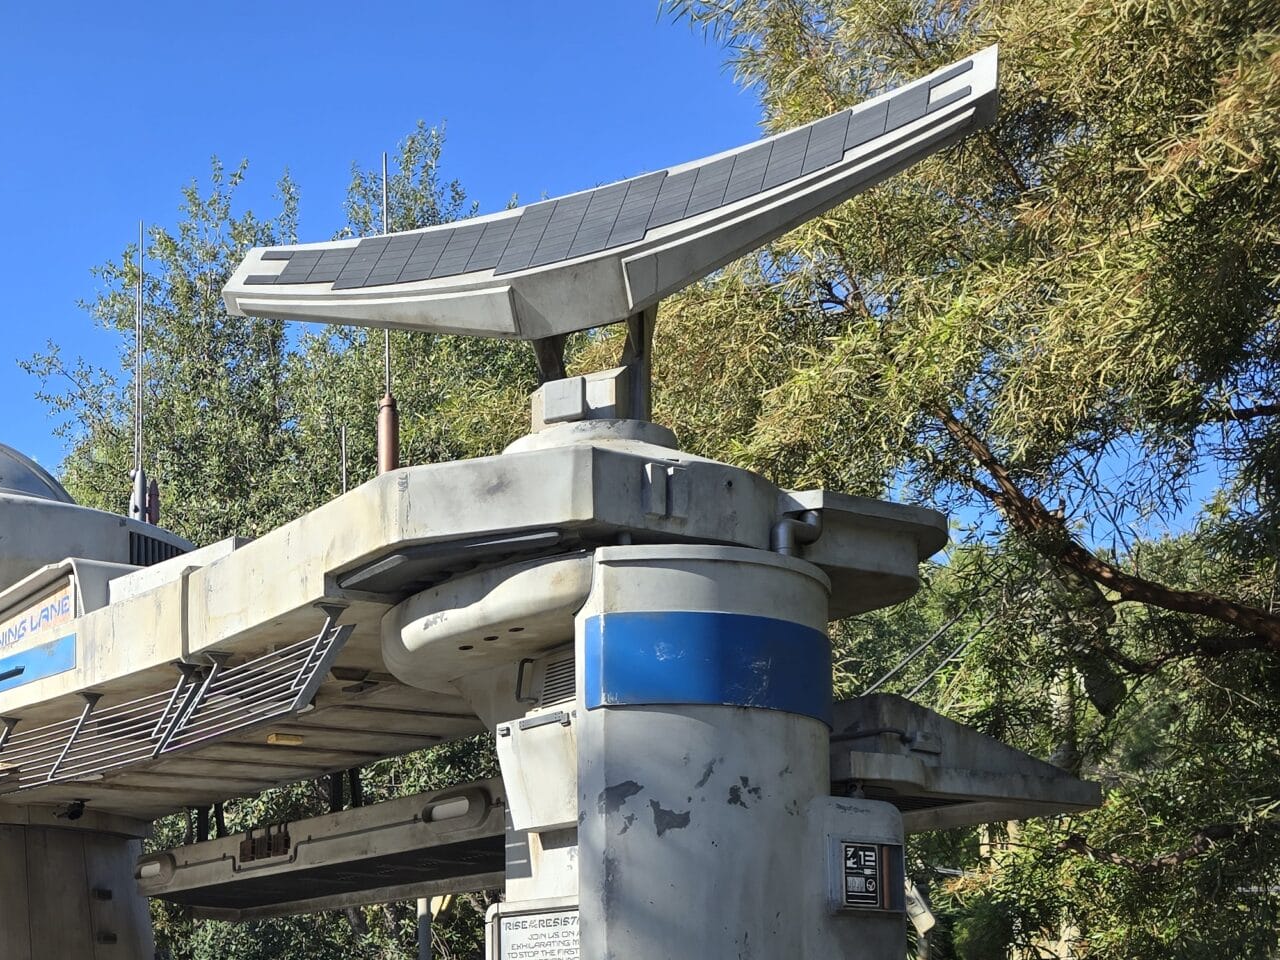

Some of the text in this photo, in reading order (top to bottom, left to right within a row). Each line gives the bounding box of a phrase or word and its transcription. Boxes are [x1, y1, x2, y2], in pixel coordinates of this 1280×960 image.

[30, 594, 70, 630] LANE
[505, 921, 527, 930] RISE
[539, 917, 579, 928] RESIST
[562, 930, 574, 938] ON
[512, 940, 570, 950] EXHILARATING
